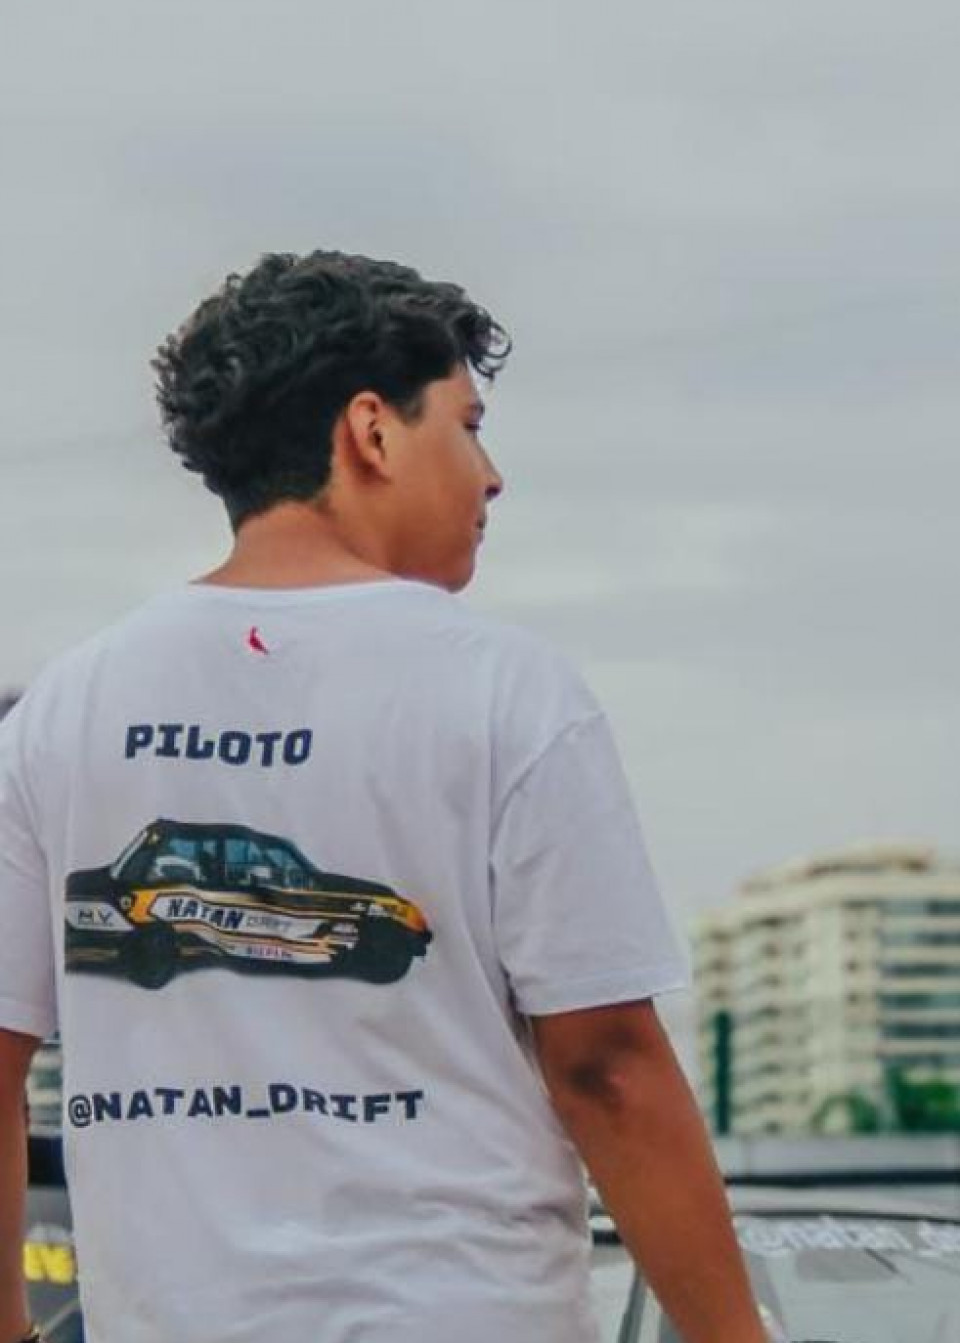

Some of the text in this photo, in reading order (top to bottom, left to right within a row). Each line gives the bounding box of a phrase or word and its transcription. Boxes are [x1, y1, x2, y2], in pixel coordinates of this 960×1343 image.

[125, 724, 313, 767] PILOTO
[167, 899, 243, 930] NATAN
[68, 1083, 425, 1128] @NATAN_DRIFT
